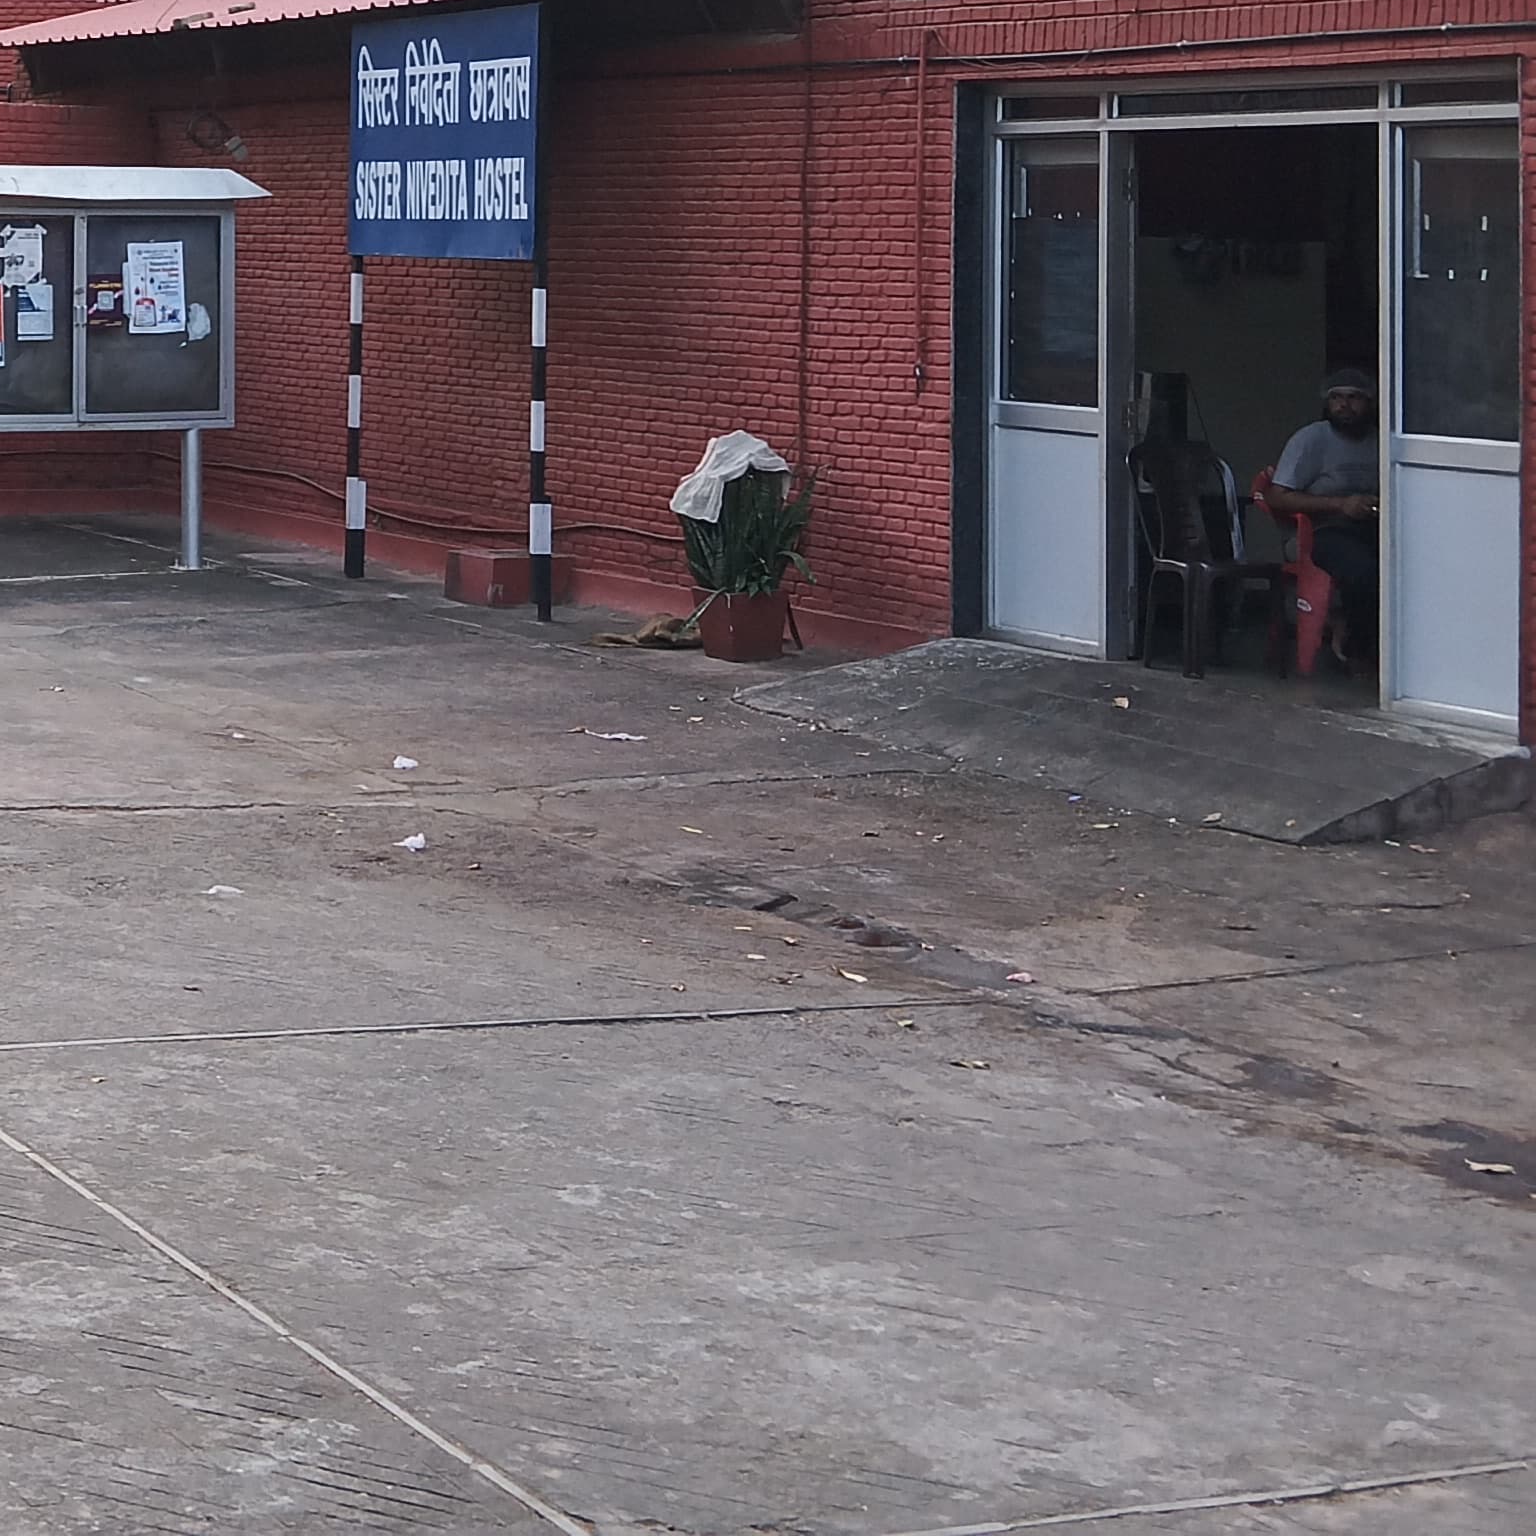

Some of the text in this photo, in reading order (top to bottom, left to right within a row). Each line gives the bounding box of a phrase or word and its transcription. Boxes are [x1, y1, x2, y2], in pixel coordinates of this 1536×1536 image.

[358, 38, 531, 128] सिस्टर निवेदिता छात्रावास
[355, 157, 528, 220] SISTER NIVEDITA HOSTEL
